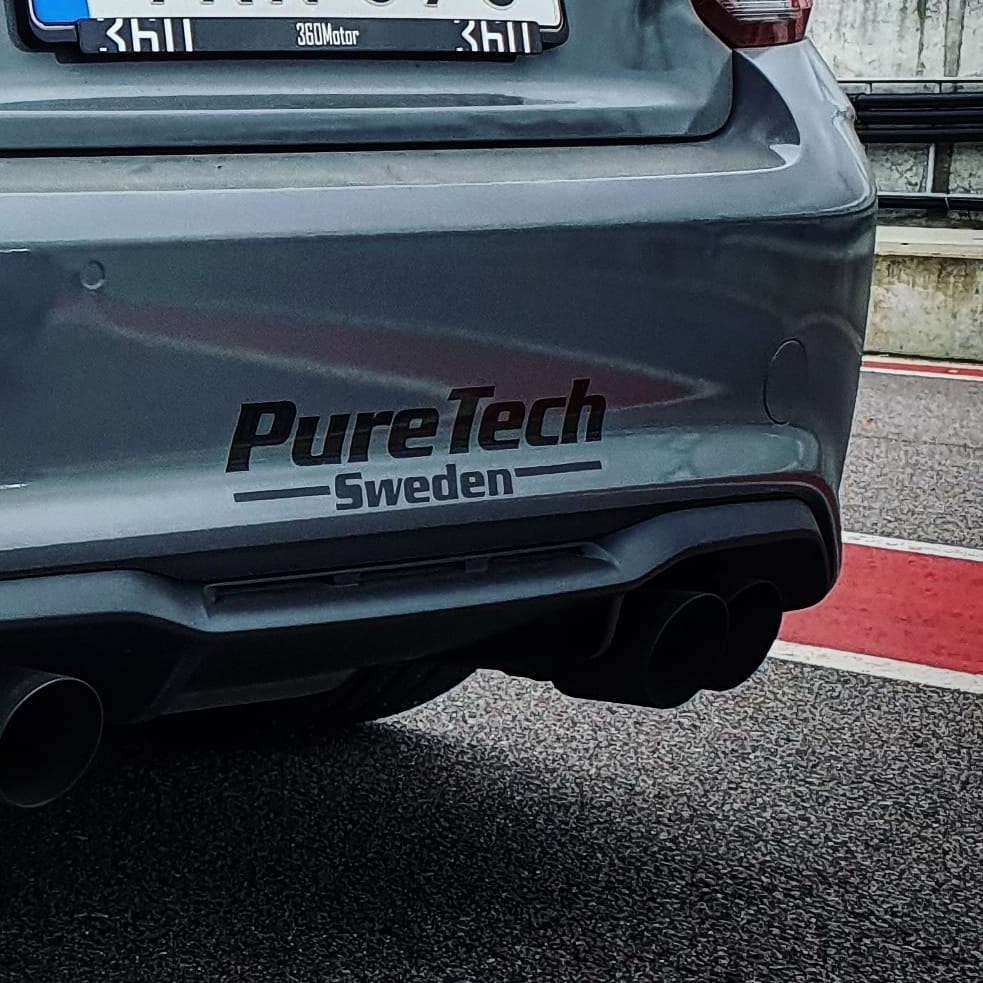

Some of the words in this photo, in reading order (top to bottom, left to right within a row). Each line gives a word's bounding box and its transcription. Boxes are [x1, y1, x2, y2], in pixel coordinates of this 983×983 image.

[296, 22, 360, 46] 360Motor
[225, 377, 608, 474] PureTech
[334, 463, 514, 511] Sweden
